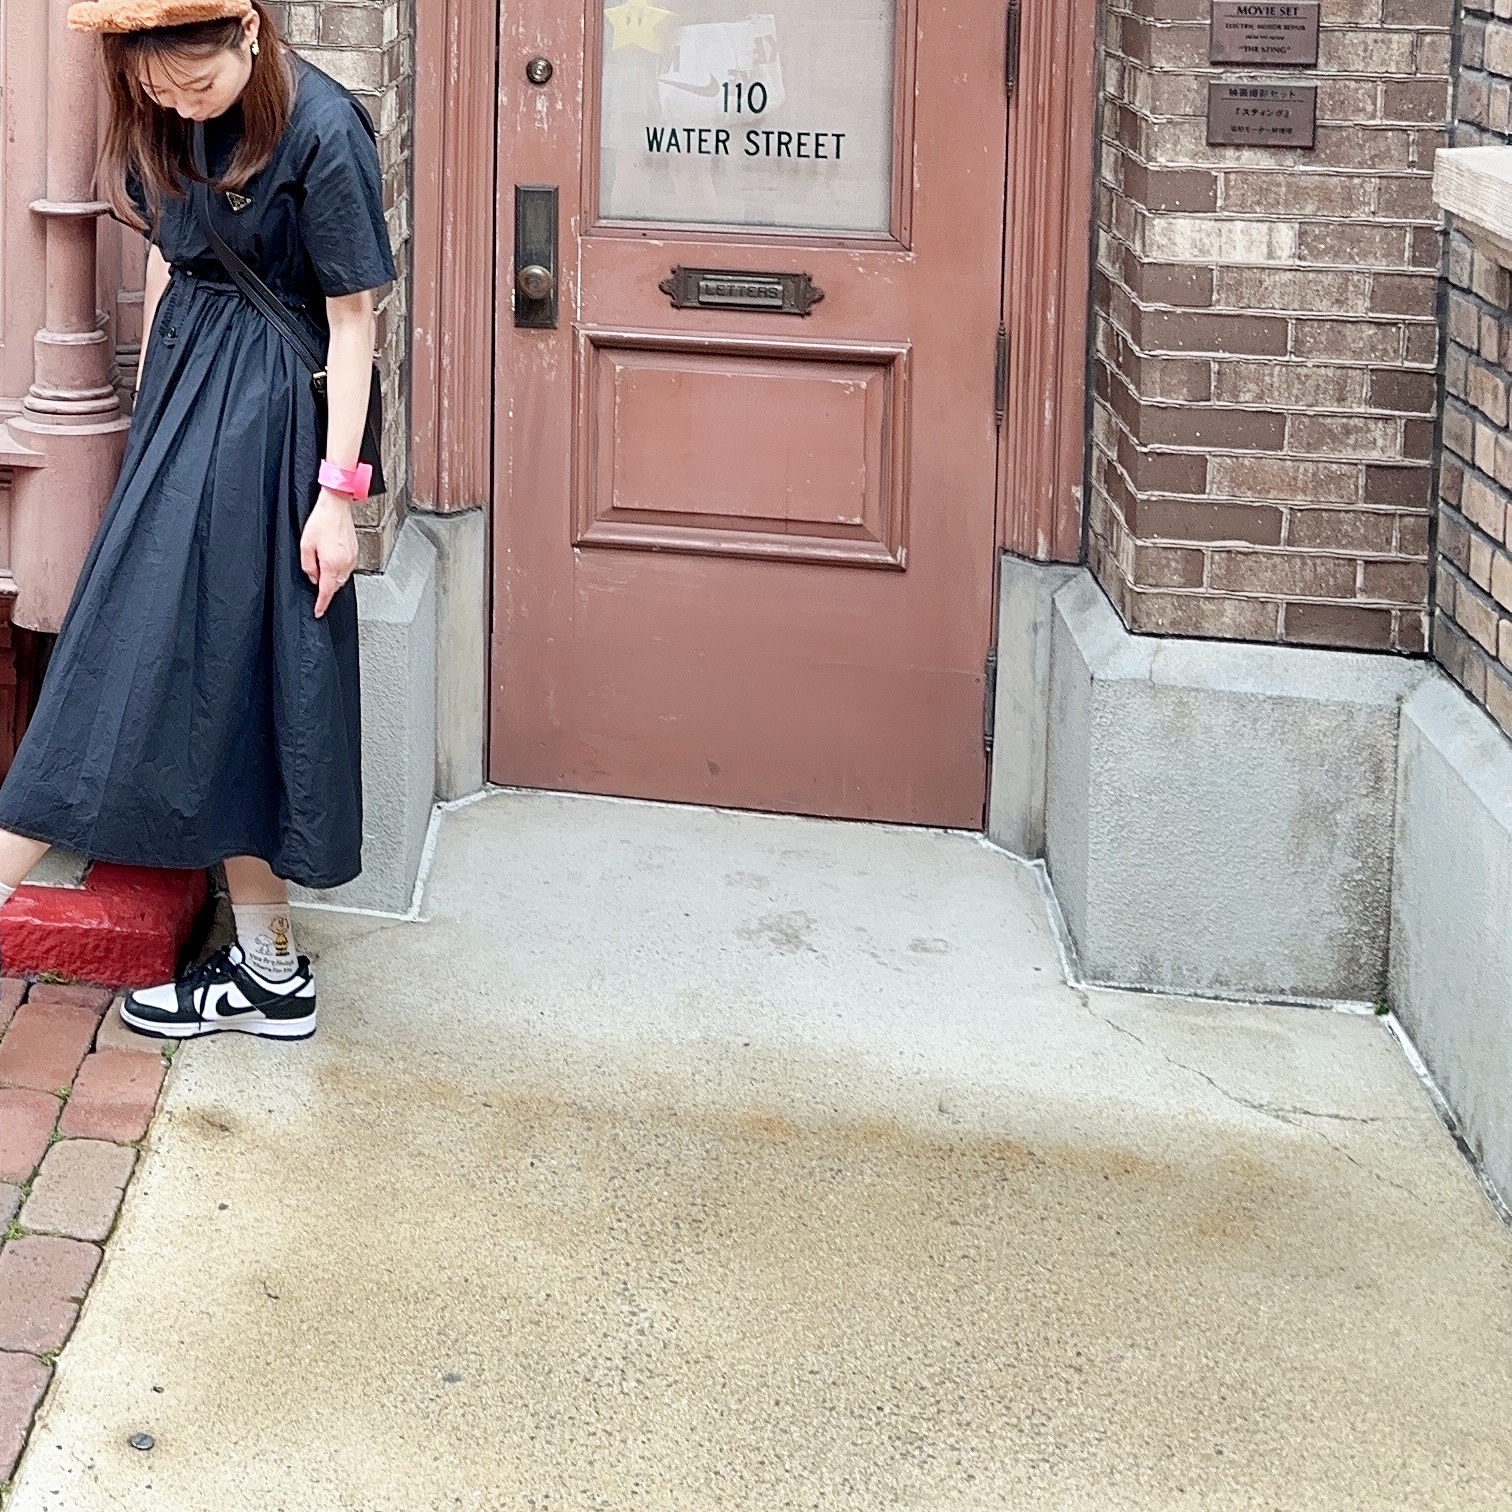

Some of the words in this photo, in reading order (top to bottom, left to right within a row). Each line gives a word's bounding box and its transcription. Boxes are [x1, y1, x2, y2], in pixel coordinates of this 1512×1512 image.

[1237, 5, 1276, 16] MOVIE
[1279, 6, 1299, 17] SET
[722, 82, 768, 114] 110
[646, 126, 731, 156] WATER
[744, 130, 846, 159] STREET
[704, 284, 780, 299] LETTERS
